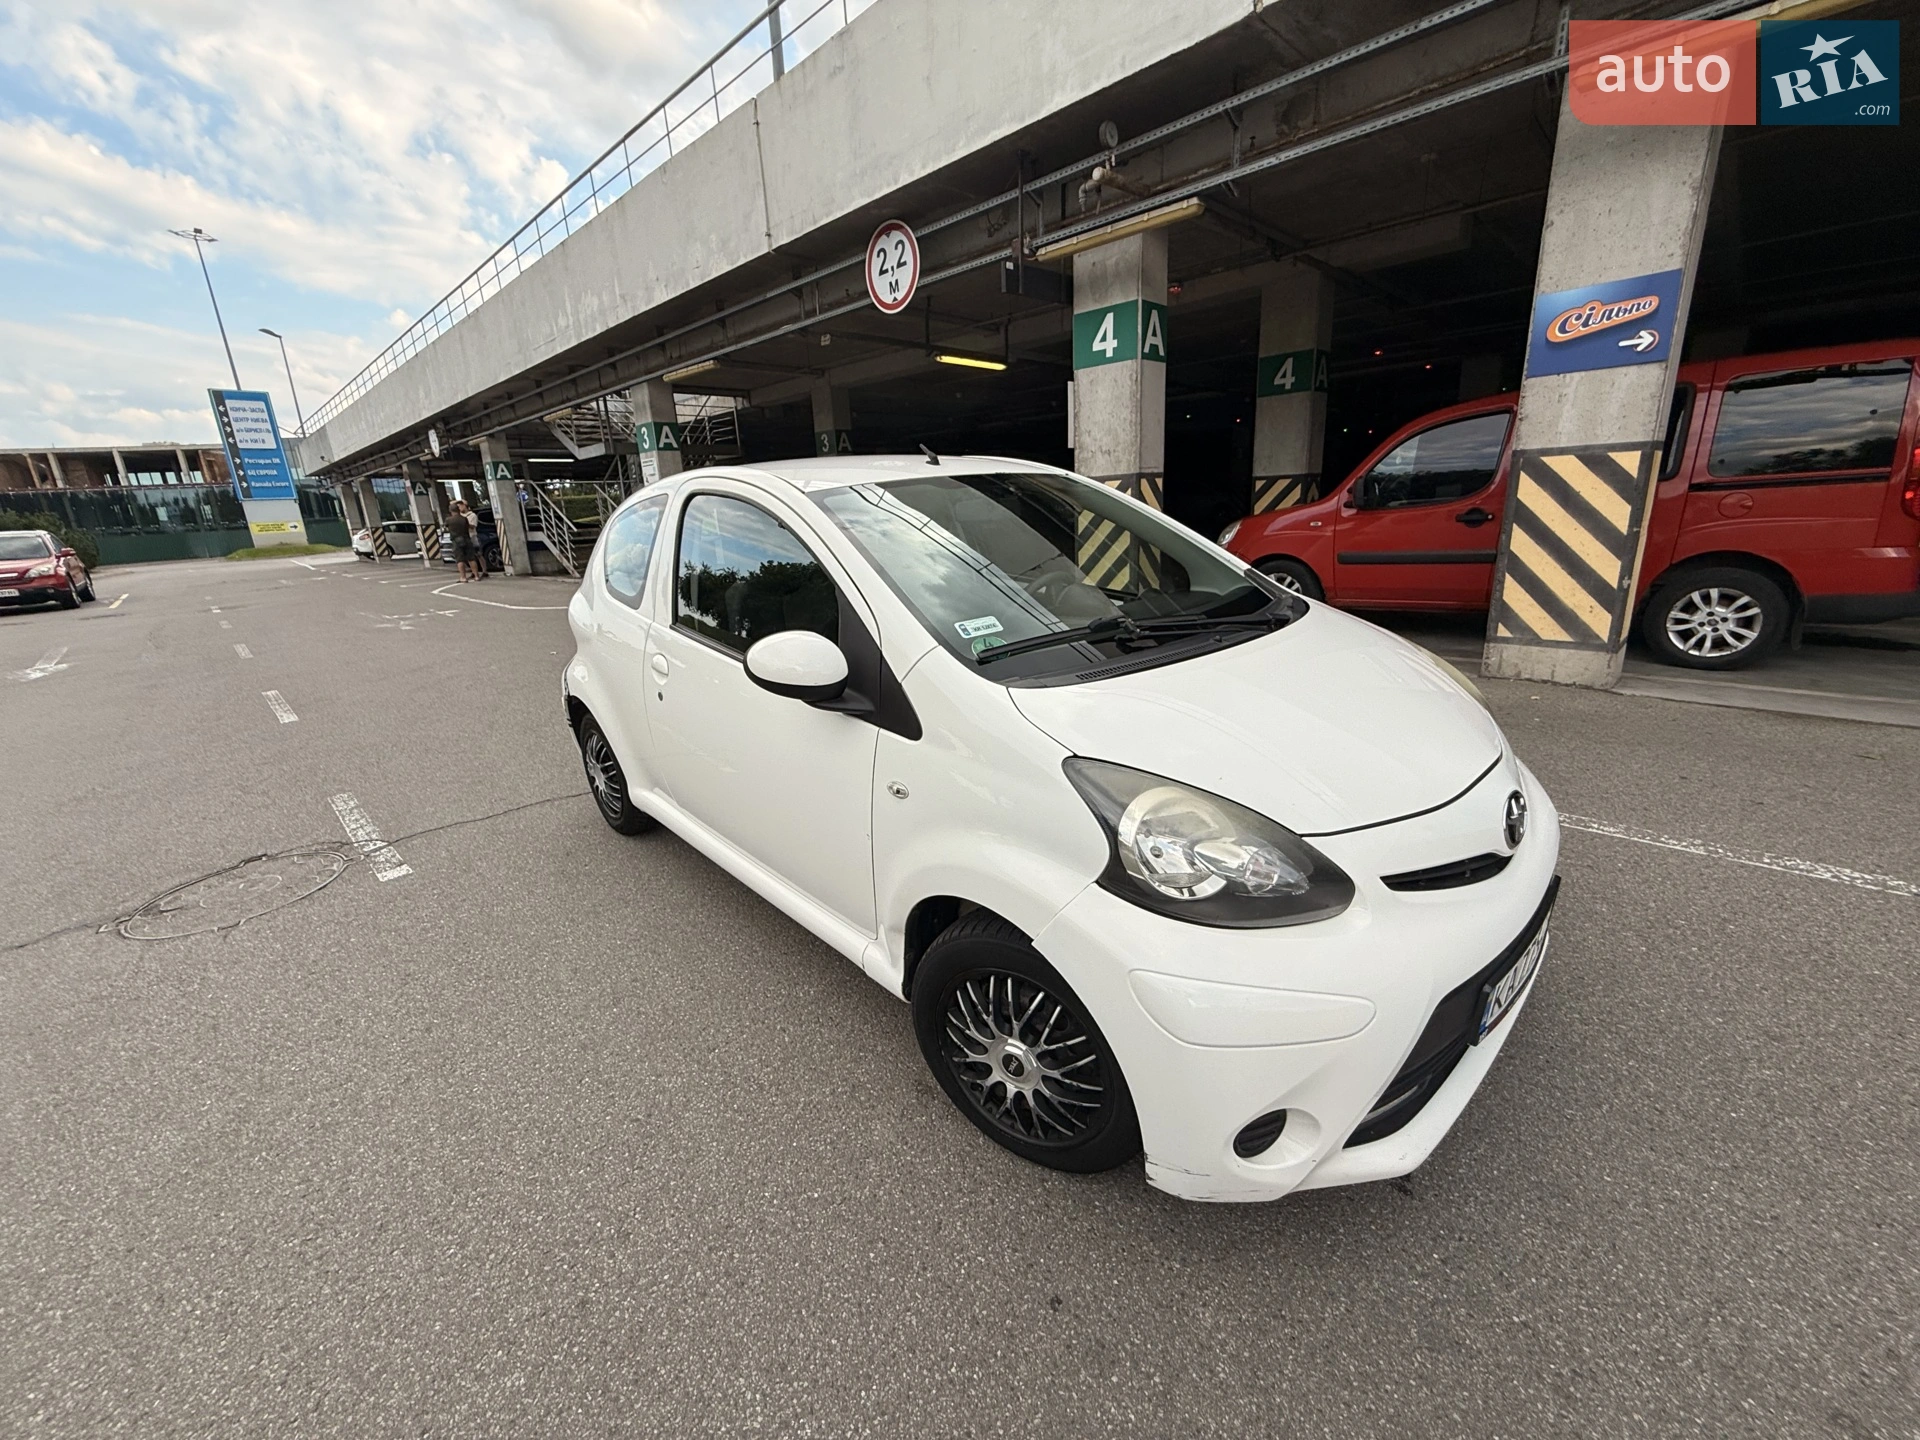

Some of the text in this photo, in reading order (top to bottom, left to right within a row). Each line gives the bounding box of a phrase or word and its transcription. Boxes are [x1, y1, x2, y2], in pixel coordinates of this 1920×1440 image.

[876, 239, 908, 278] 2,2
[1554, 299, 1655, 337] Сільпо
[1092, 309, 1165, 358] 4 A
[1273, 356, 1296, 390] 4
[641, 425, 679, 449] 3 A
[820, 431, 853, 452] 3 A
[496, 463, 511, 479] A
[414, 482, 428, 495] A
